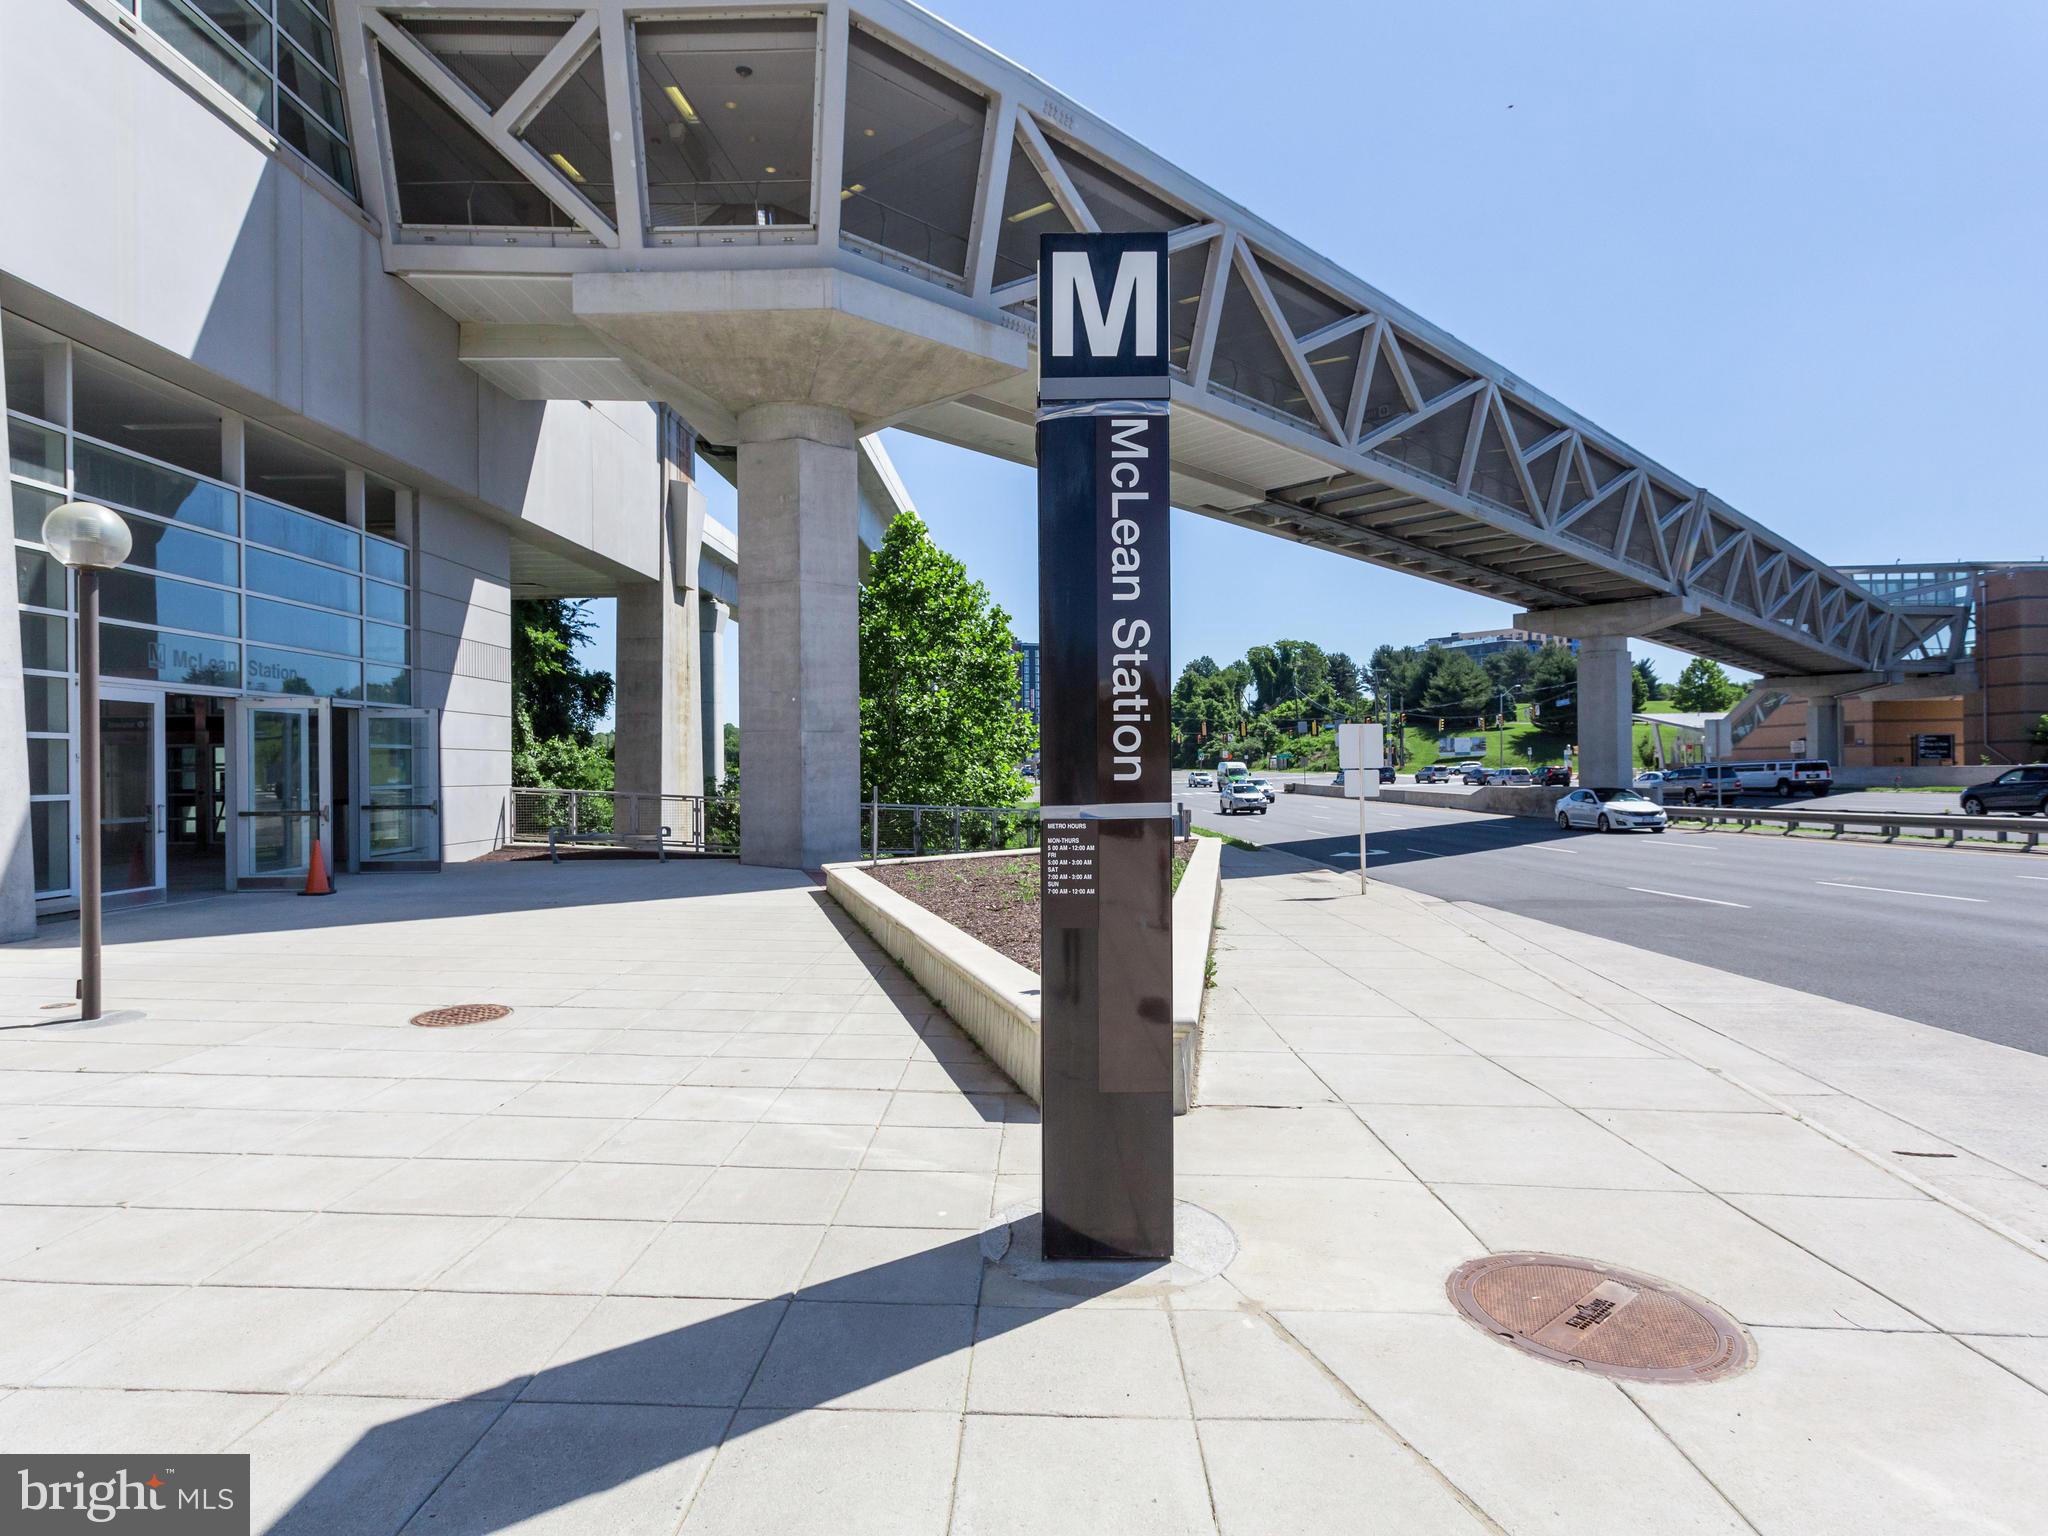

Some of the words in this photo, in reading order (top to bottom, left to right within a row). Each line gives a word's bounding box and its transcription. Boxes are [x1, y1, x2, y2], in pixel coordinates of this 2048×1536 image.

[1052, 251, 1158, 357] M
[1110, 419, 1149, 601] McLean
[248, 660, 298, 680] Station
[1111, 618, 1151, 781] Station
